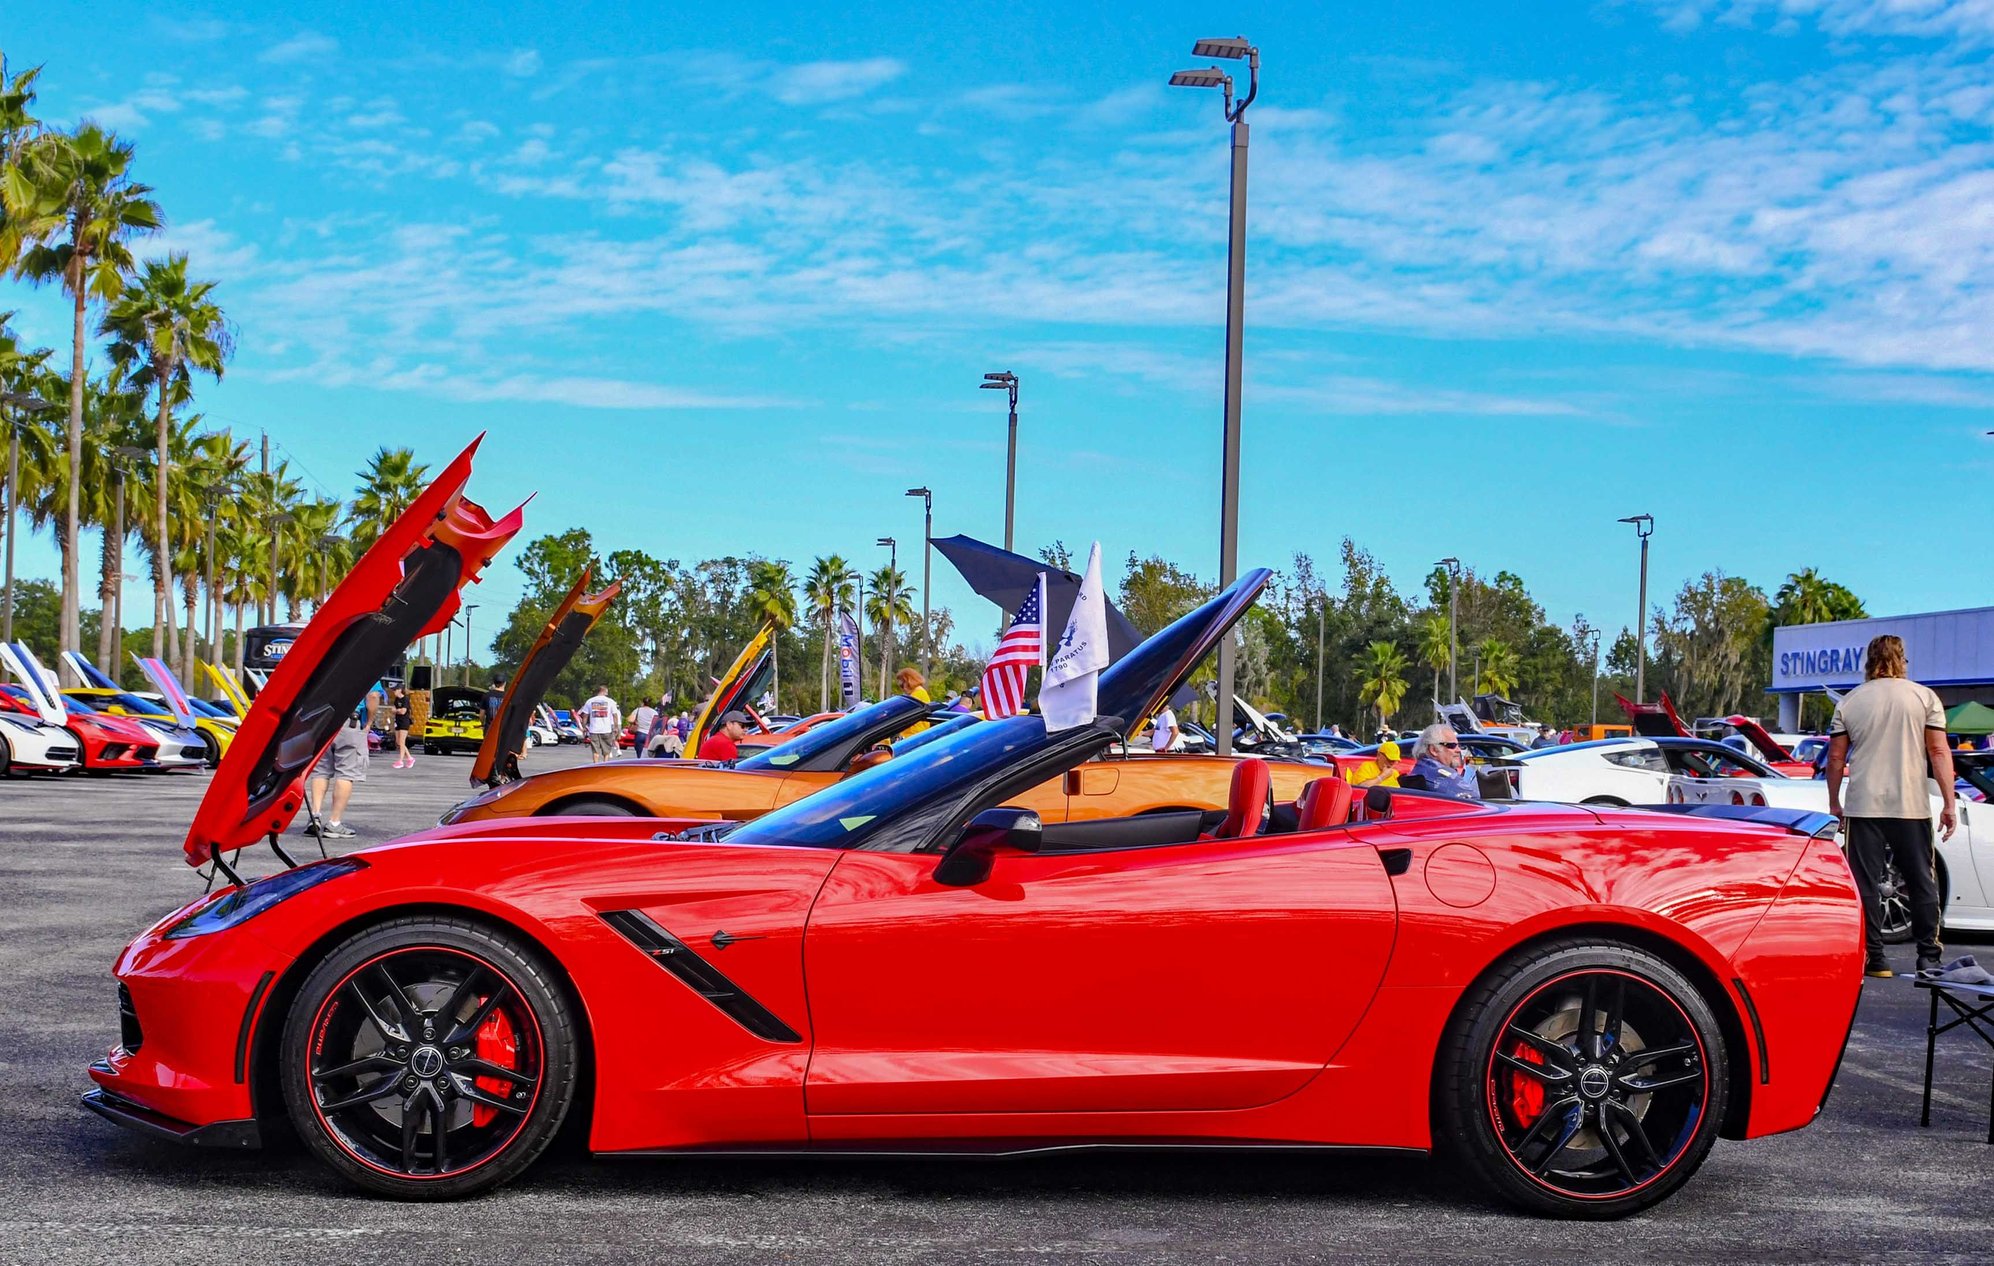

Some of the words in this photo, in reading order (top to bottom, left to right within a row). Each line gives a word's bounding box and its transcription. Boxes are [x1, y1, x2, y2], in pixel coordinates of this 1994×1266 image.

[841, 634, 854, 678] Mobil
[1055, 640, 1087, 664] PARATUS
[1780, 646, 1864, 676] STINGRAY
[1050, 662, 1068, 673] 1790
